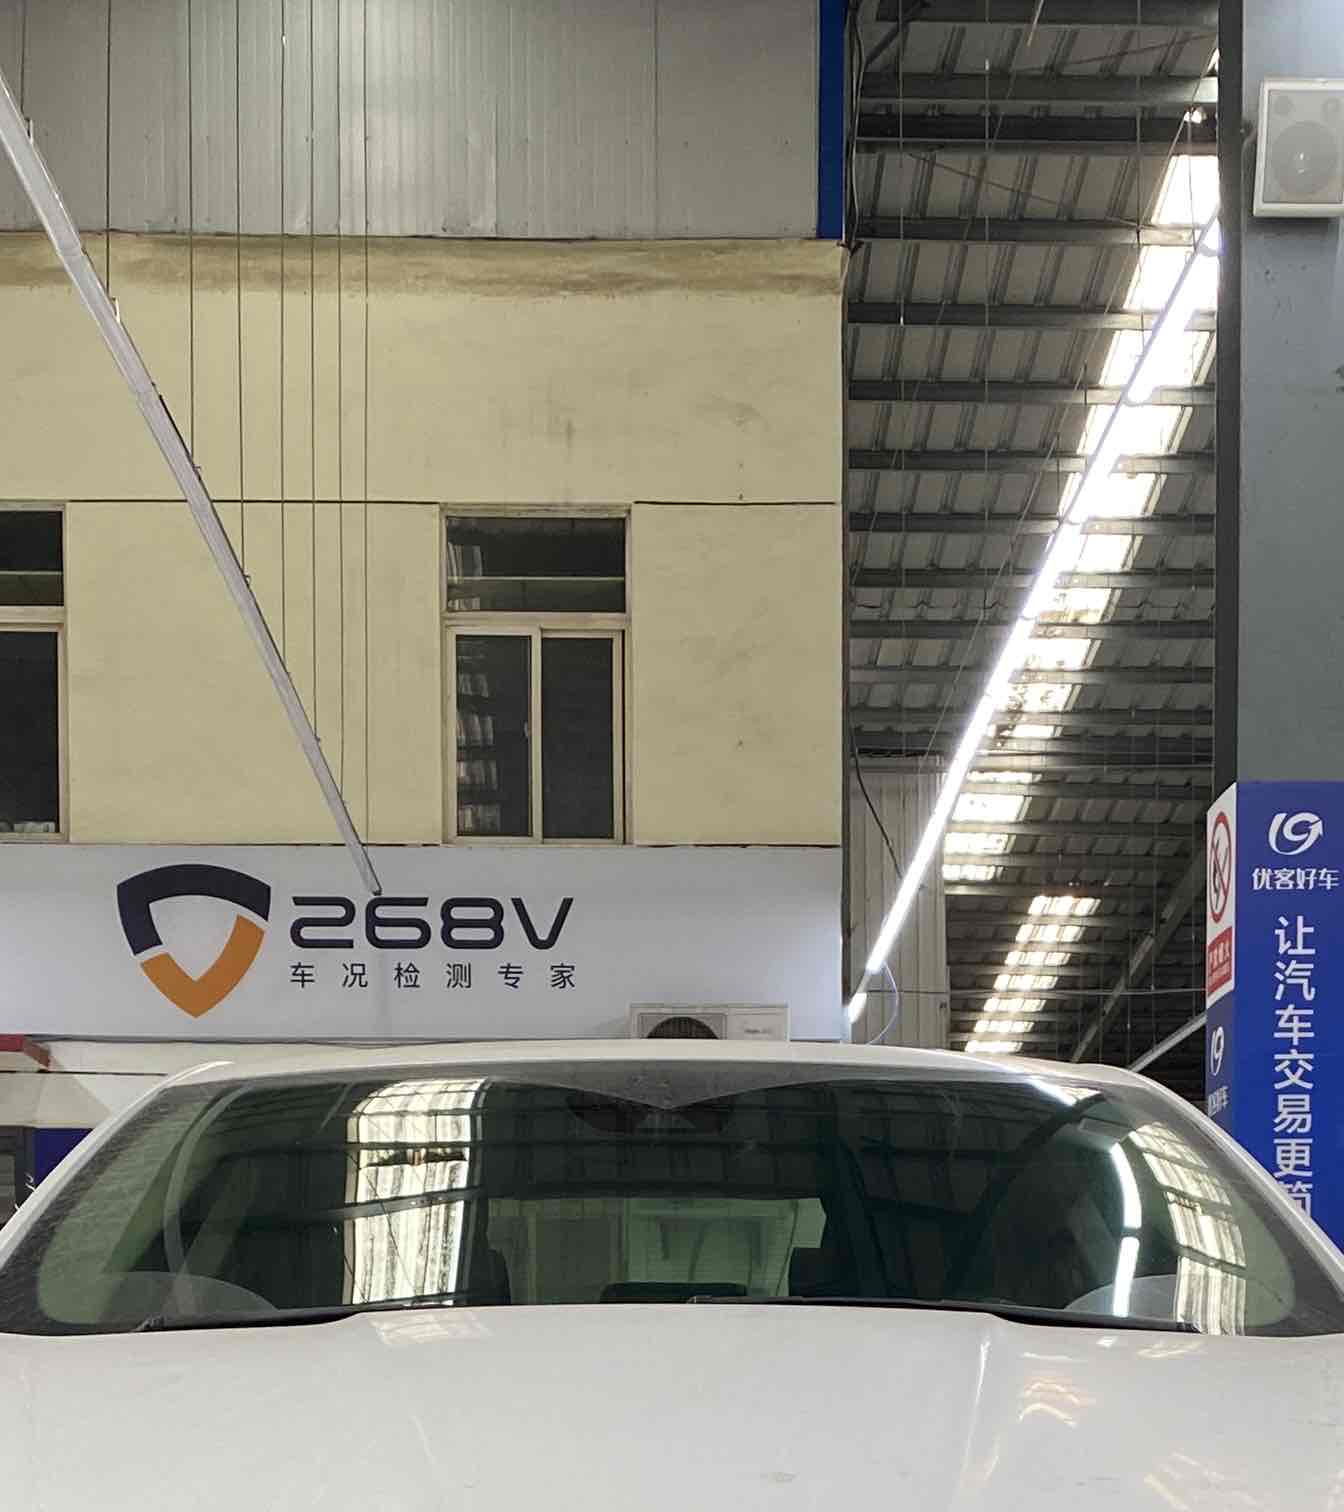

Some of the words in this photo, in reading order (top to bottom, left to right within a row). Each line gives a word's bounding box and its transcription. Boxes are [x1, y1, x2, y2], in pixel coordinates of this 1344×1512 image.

[1252, 867, 1339, 890] 优客好车
[289, 896, 575, 950] 268V
[289, 961, 577, 990] 车况检测专家
